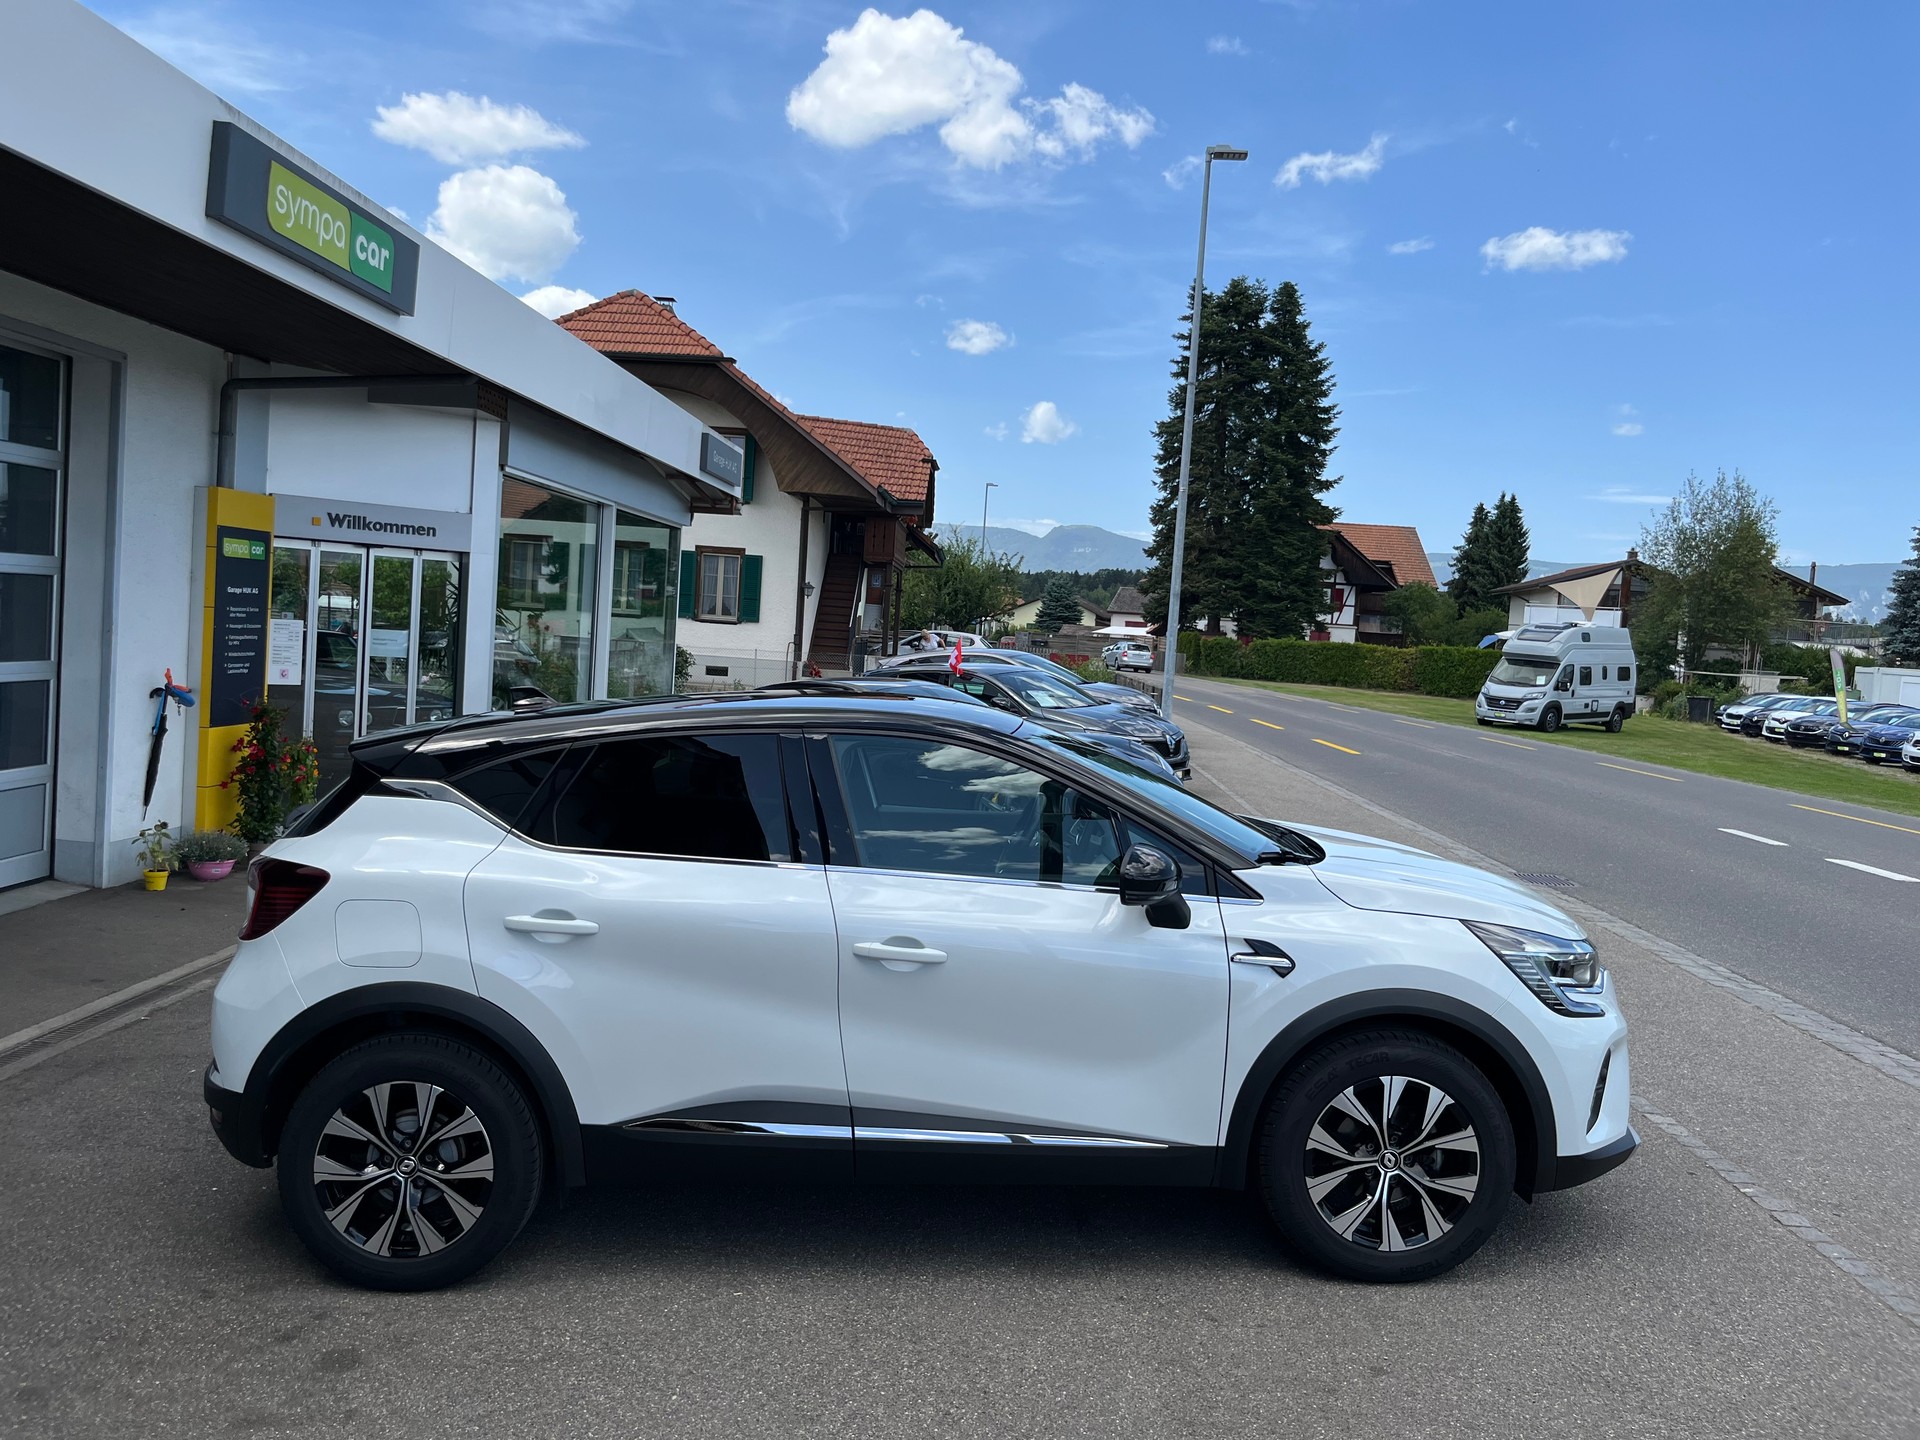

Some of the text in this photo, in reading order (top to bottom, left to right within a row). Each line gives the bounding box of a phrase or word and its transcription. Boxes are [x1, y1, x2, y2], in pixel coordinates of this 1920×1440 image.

[275, 184, 390, 272] sympa car
[326, 511, 437, 538] Willkommen
[225, 543, 264, 555] sympa car
[227, 586, 242, 595] Garage
[252, 587, 259, 595] AG
[1345, 1051, 1390, 1072] TECAR
